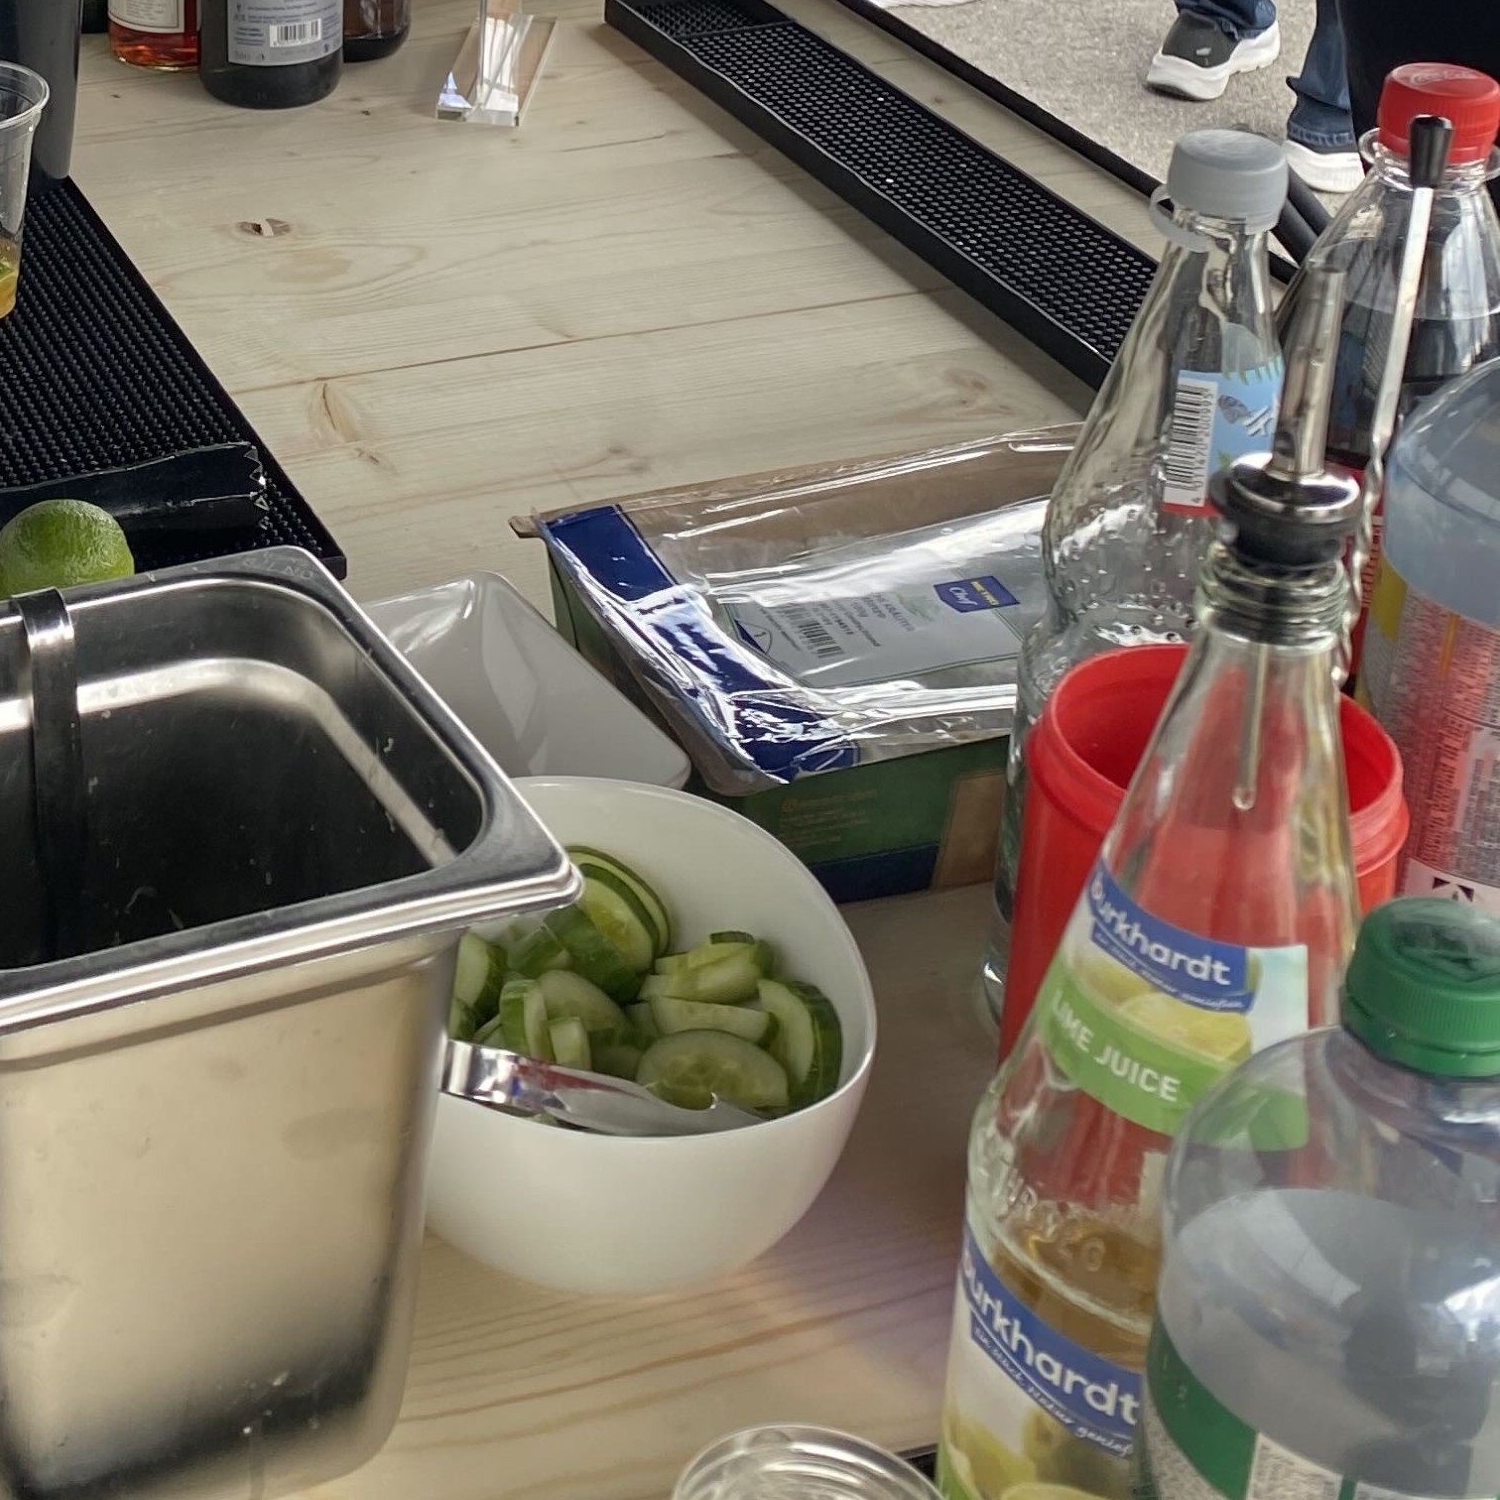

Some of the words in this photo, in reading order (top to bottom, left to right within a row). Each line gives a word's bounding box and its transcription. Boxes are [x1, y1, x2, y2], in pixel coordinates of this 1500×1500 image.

[949, 587, 979, 606] Chef
[1090, 871, 1231, 986] burkhardt
[1052, 990, 1095, 1052] LIME
[1094, 1046, 1180, 1102] JUICE
[961, 1248, 1140, 1426] burkhardt
